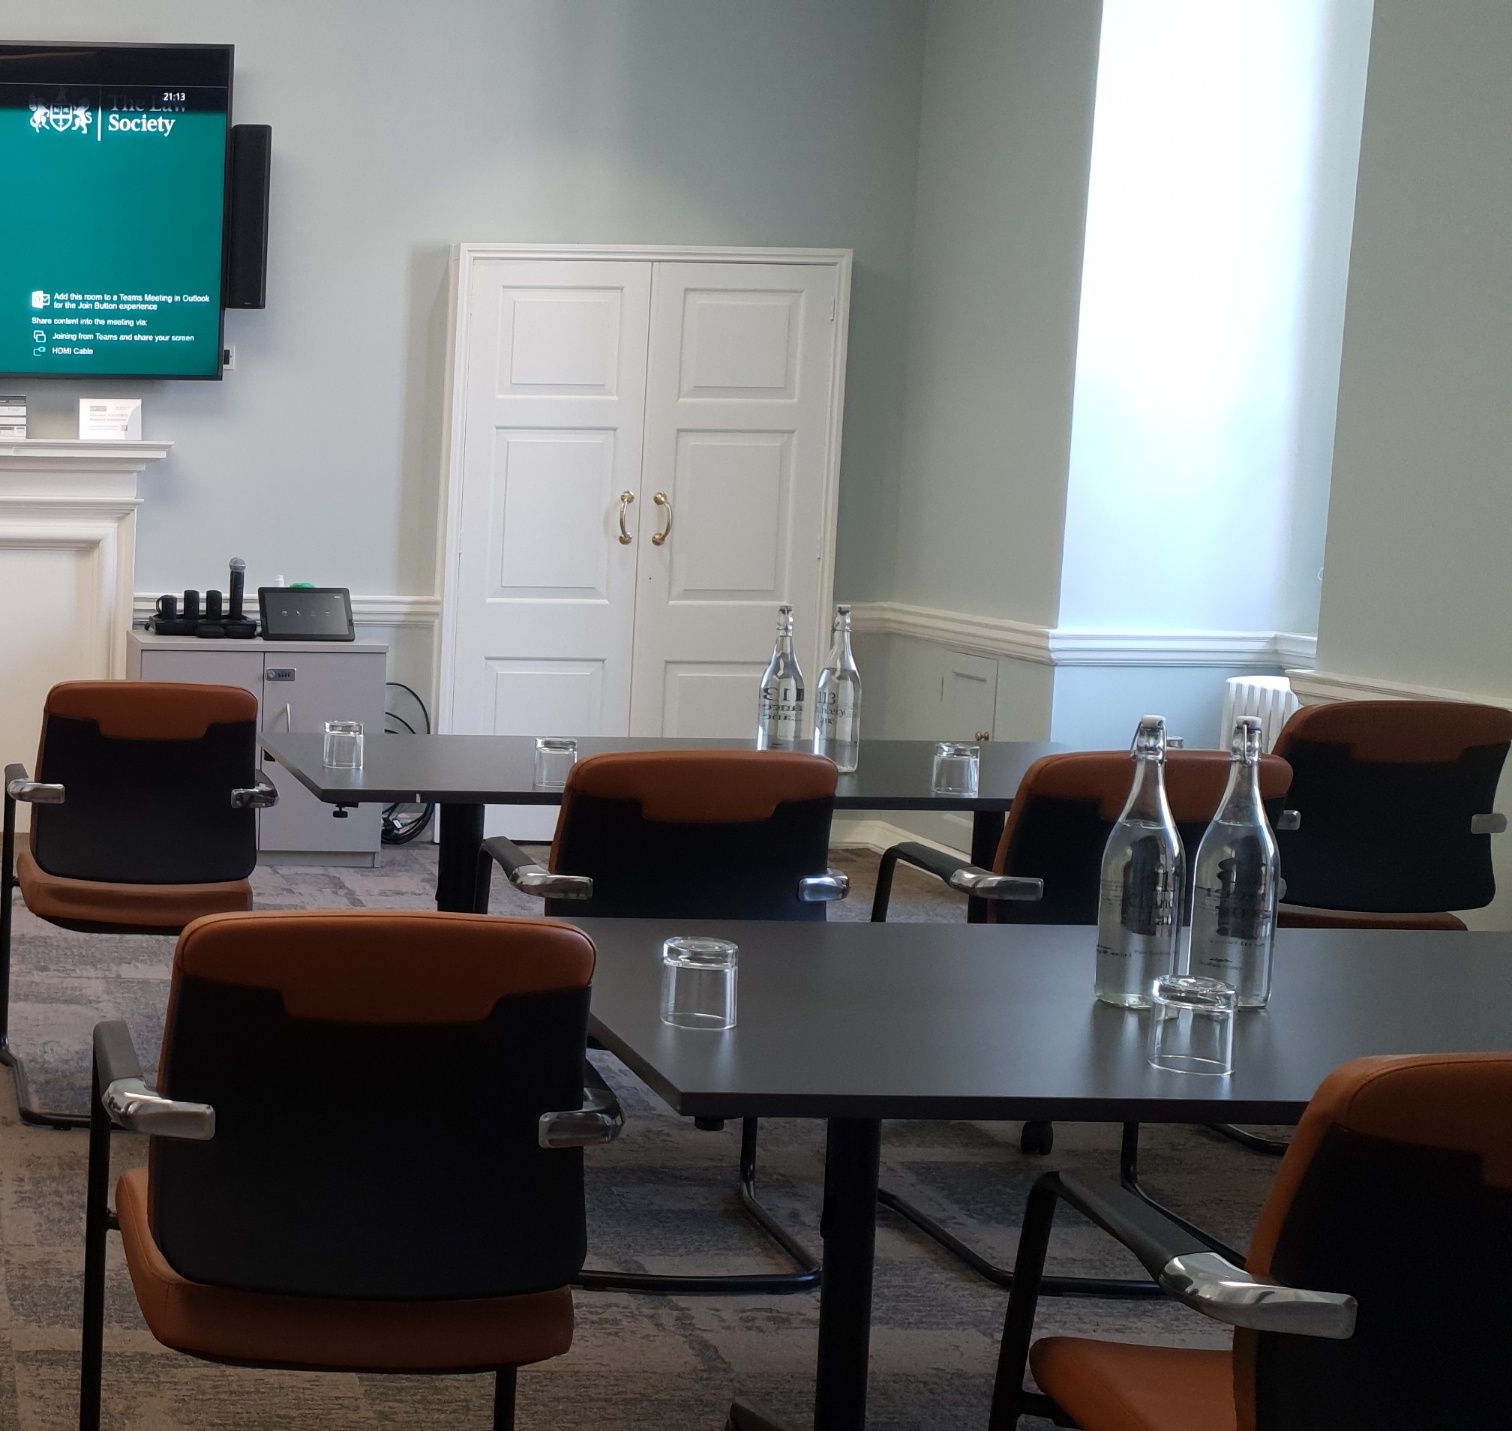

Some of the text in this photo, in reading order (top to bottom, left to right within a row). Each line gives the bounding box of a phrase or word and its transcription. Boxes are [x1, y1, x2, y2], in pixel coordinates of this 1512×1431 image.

[163, 93, 186, 101] 21:13
[108, 114, 176, 137] Society
[54, 293, 69, 301] Add
[70, 293, 83, 301] this
[119, 294, 143, 302] Teams
[144, 294, 173, 303] Meeting
[94, 302, 118, 310] Button
[119, 303, 158, 311] experience
[32, 317, 52, 325] Share
[107, 318, 135, 327] meeting
[52, 333, 77, 341] Joining
[95, 333, 118, 341] Teams
[154, 335, 170, 343] your
[52, 347, 72, 355] HDMI
